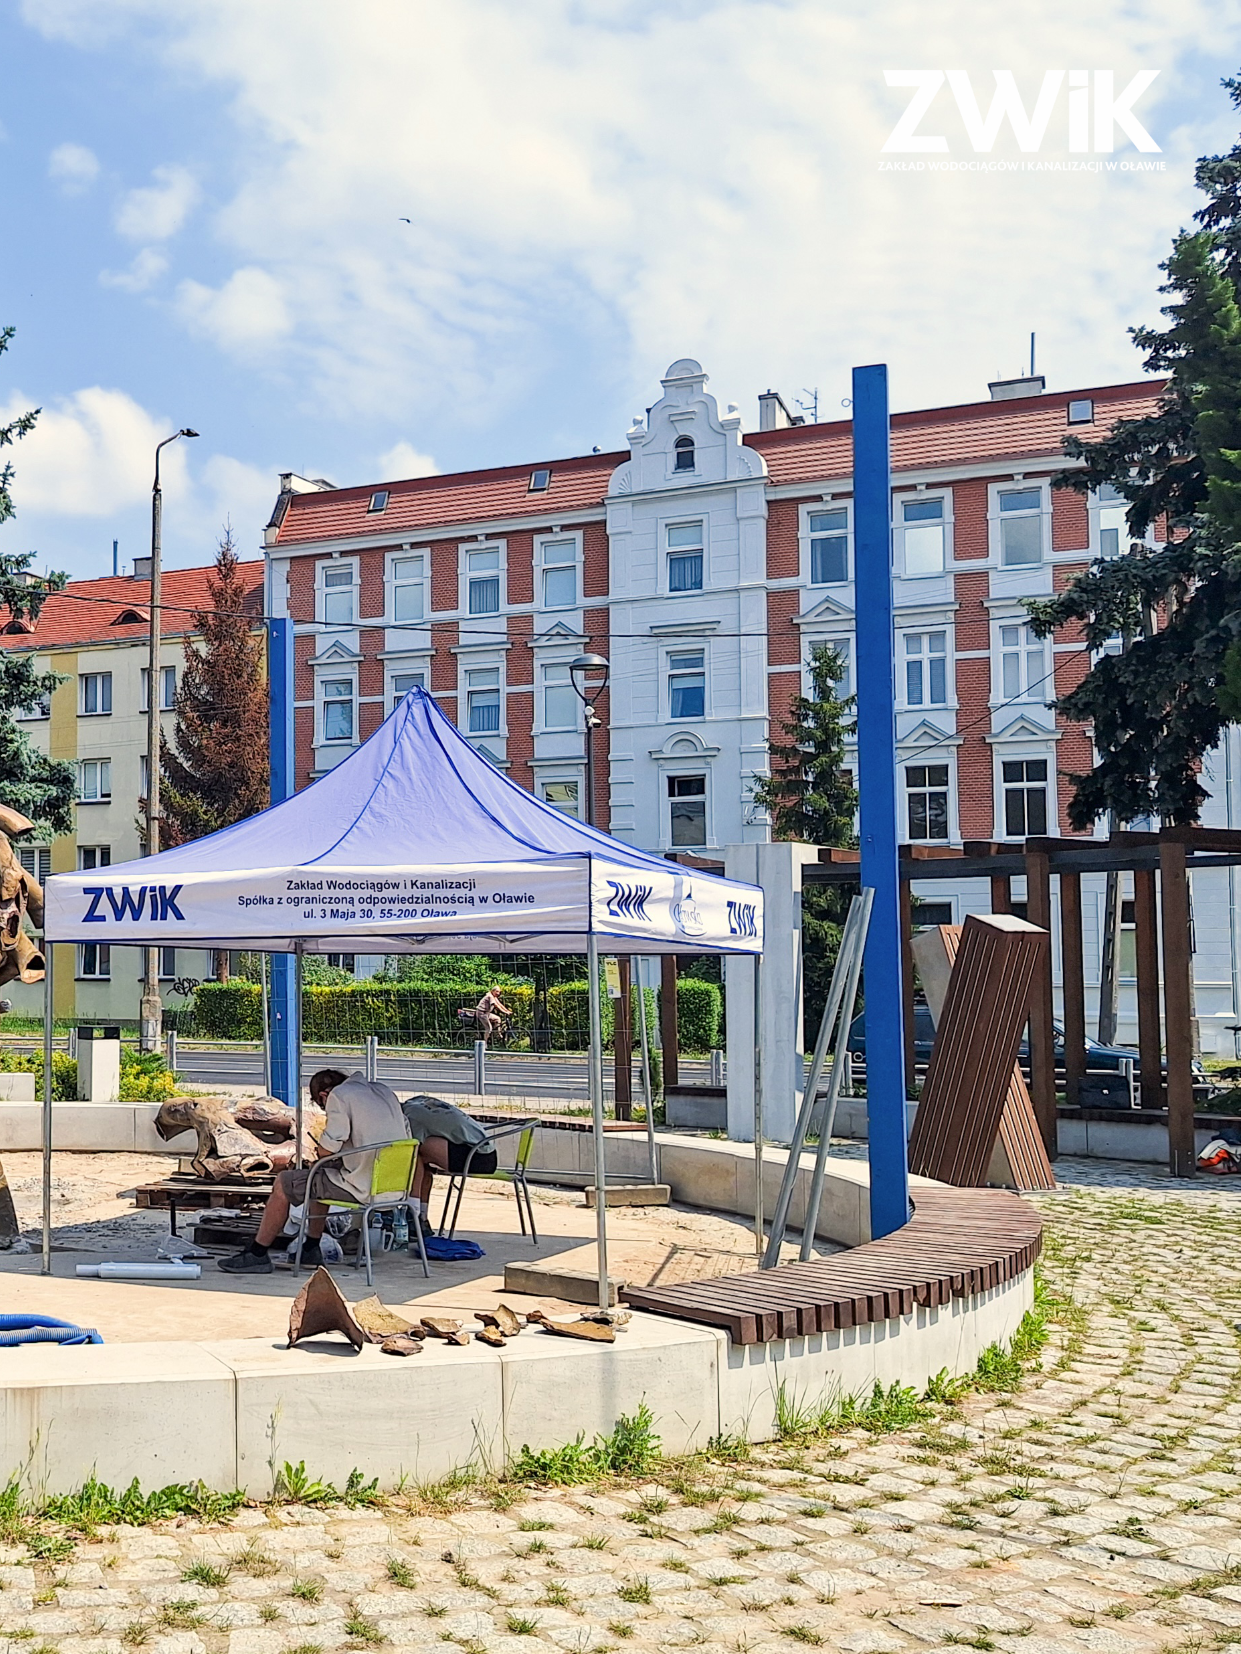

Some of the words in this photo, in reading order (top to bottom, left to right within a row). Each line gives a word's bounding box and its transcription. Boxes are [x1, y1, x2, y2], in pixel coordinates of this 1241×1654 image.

[286, 880, 323, 891] Zakład
[326, 879, 400, 893] Wodociągów
[410, 879, 476, 892] Kanalizacji
[81, 884, 186, 923] ZWiK
[238, 894, 274, 908] Spółka
[286, 894, 355, 907] ograniczoną
[358, 893, 475, 907] odpowiedzialnością
[478, 895, 489, 904] w
[492, 892, 535, 904] Oławie
[606, 879, 653, 922] ZWiK
[303, 908, 316, 919] ul.
[320, 908, 327, 919] 3
[330, 908, 356, 921] Maja
[359, 908, 376, 920] 30,
[379, 908, 418, 919] 55-200
[726, 900, 758, 938] ZWiK
